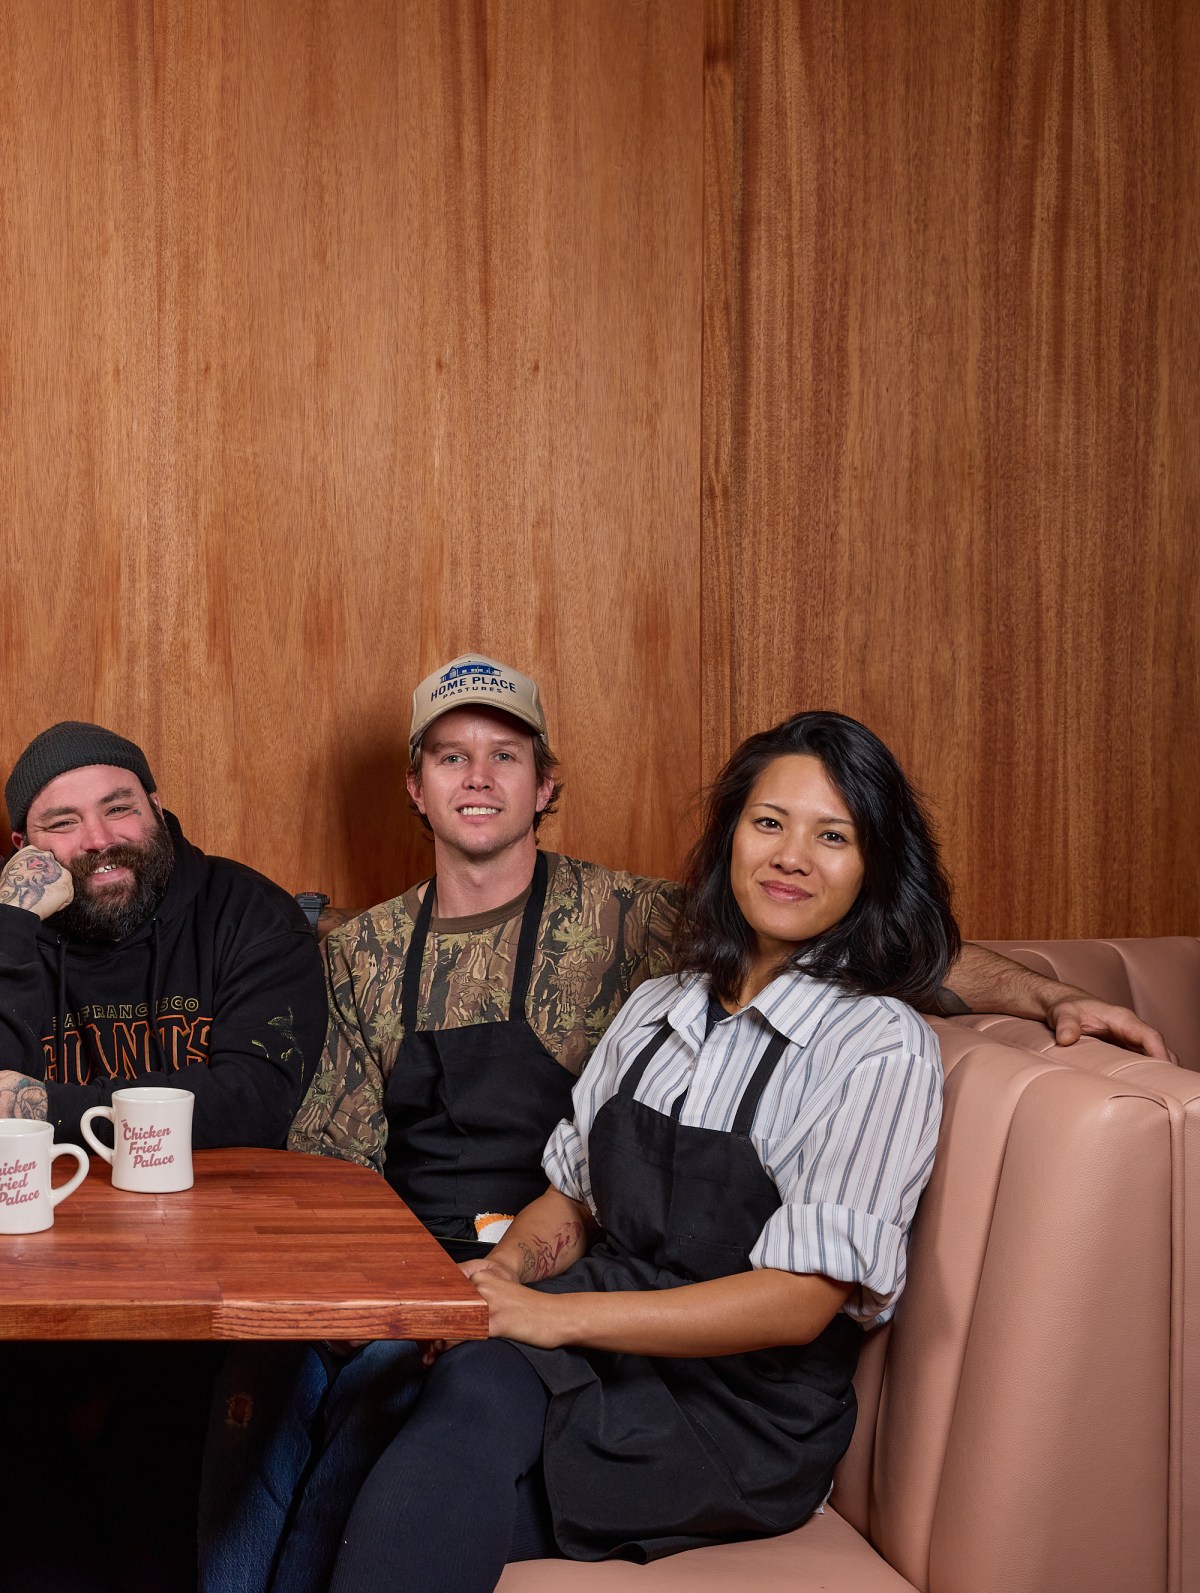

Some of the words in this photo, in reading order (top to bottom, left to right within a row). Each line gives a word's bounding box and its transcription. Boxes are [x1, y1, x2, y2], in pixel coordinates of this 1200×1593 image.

[430, 677, 467, 702] HOME
[472, 676, 517, 694] PLACE
[442, 686, 503, 700] PASTURES
[123, 1125, 172, 1141] Chicken
[129, 1138, 163, 1155] Fried
[133, 1153, 175, 1168] Palace
